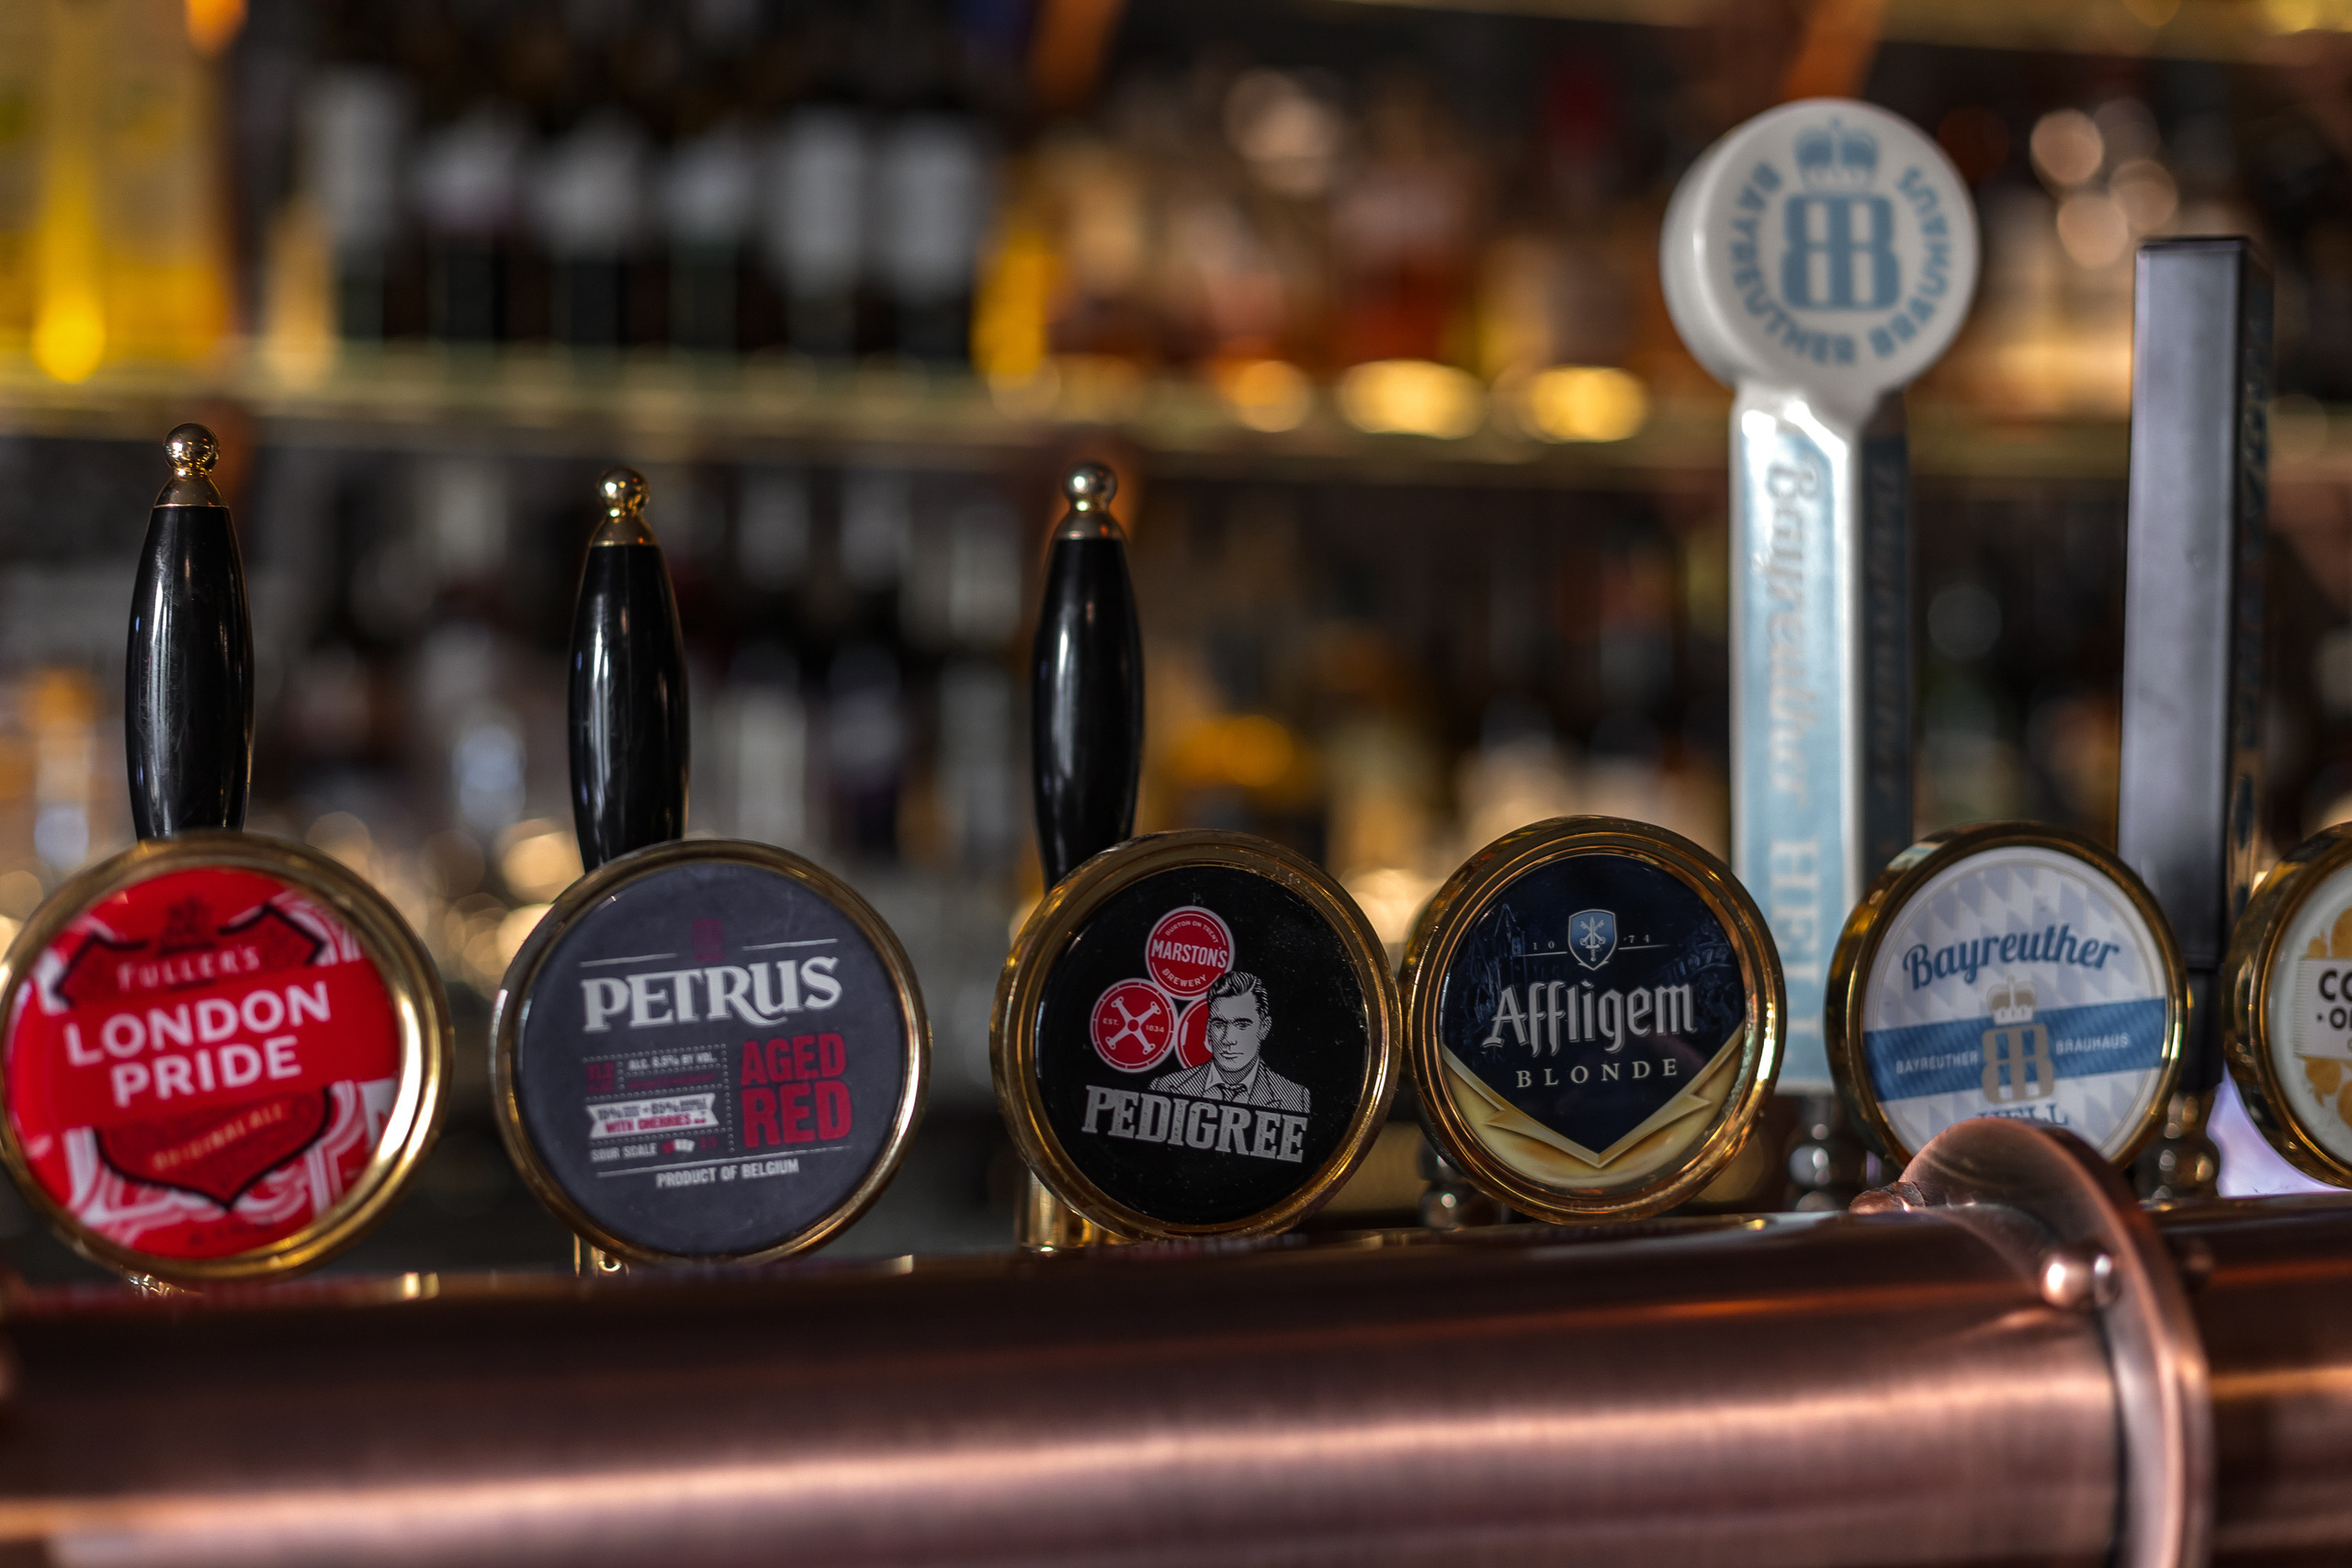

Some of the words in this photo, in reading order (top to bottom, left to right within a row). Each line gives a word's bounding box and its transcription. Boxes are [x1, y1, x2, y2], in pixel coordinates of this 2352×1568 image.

[1151, 939, 1227, 968] MARSTON'S
[1203, 924, 1219, 943] TRENT
[1902, 923, 2120, 991] Bayreuther
[580, 955, 843, 1033] PETRUS
[1161, 967, 1207, 987] BREWERY
[63, 980, 332, 1066] LONDON
[1102, 1017, 1119, 1026] EST.
[1480, 979, 1697, 1058] Affligem
[109, 1035, 302, 1108] PRIDE
[741, 1032, 847, 1086] AGED
[1516, 1058, 1679, 1089] BLONDE
[1895, 1050, 1979, 1075] BAYREUTHER
[2055, 1032, 2130, 1055] BRAUHAUS
[741, 1079, 853, 1148] RED
[1080, 1084, 1311, 1164] PEDIGREE
[622, 1142, 658, 1160] SCALE
[655, 1168, 718, 1189] PRODUCT
[720, 1164, 738, 1182] OF
[741, 1158, 800, 1180] BELGIUM
